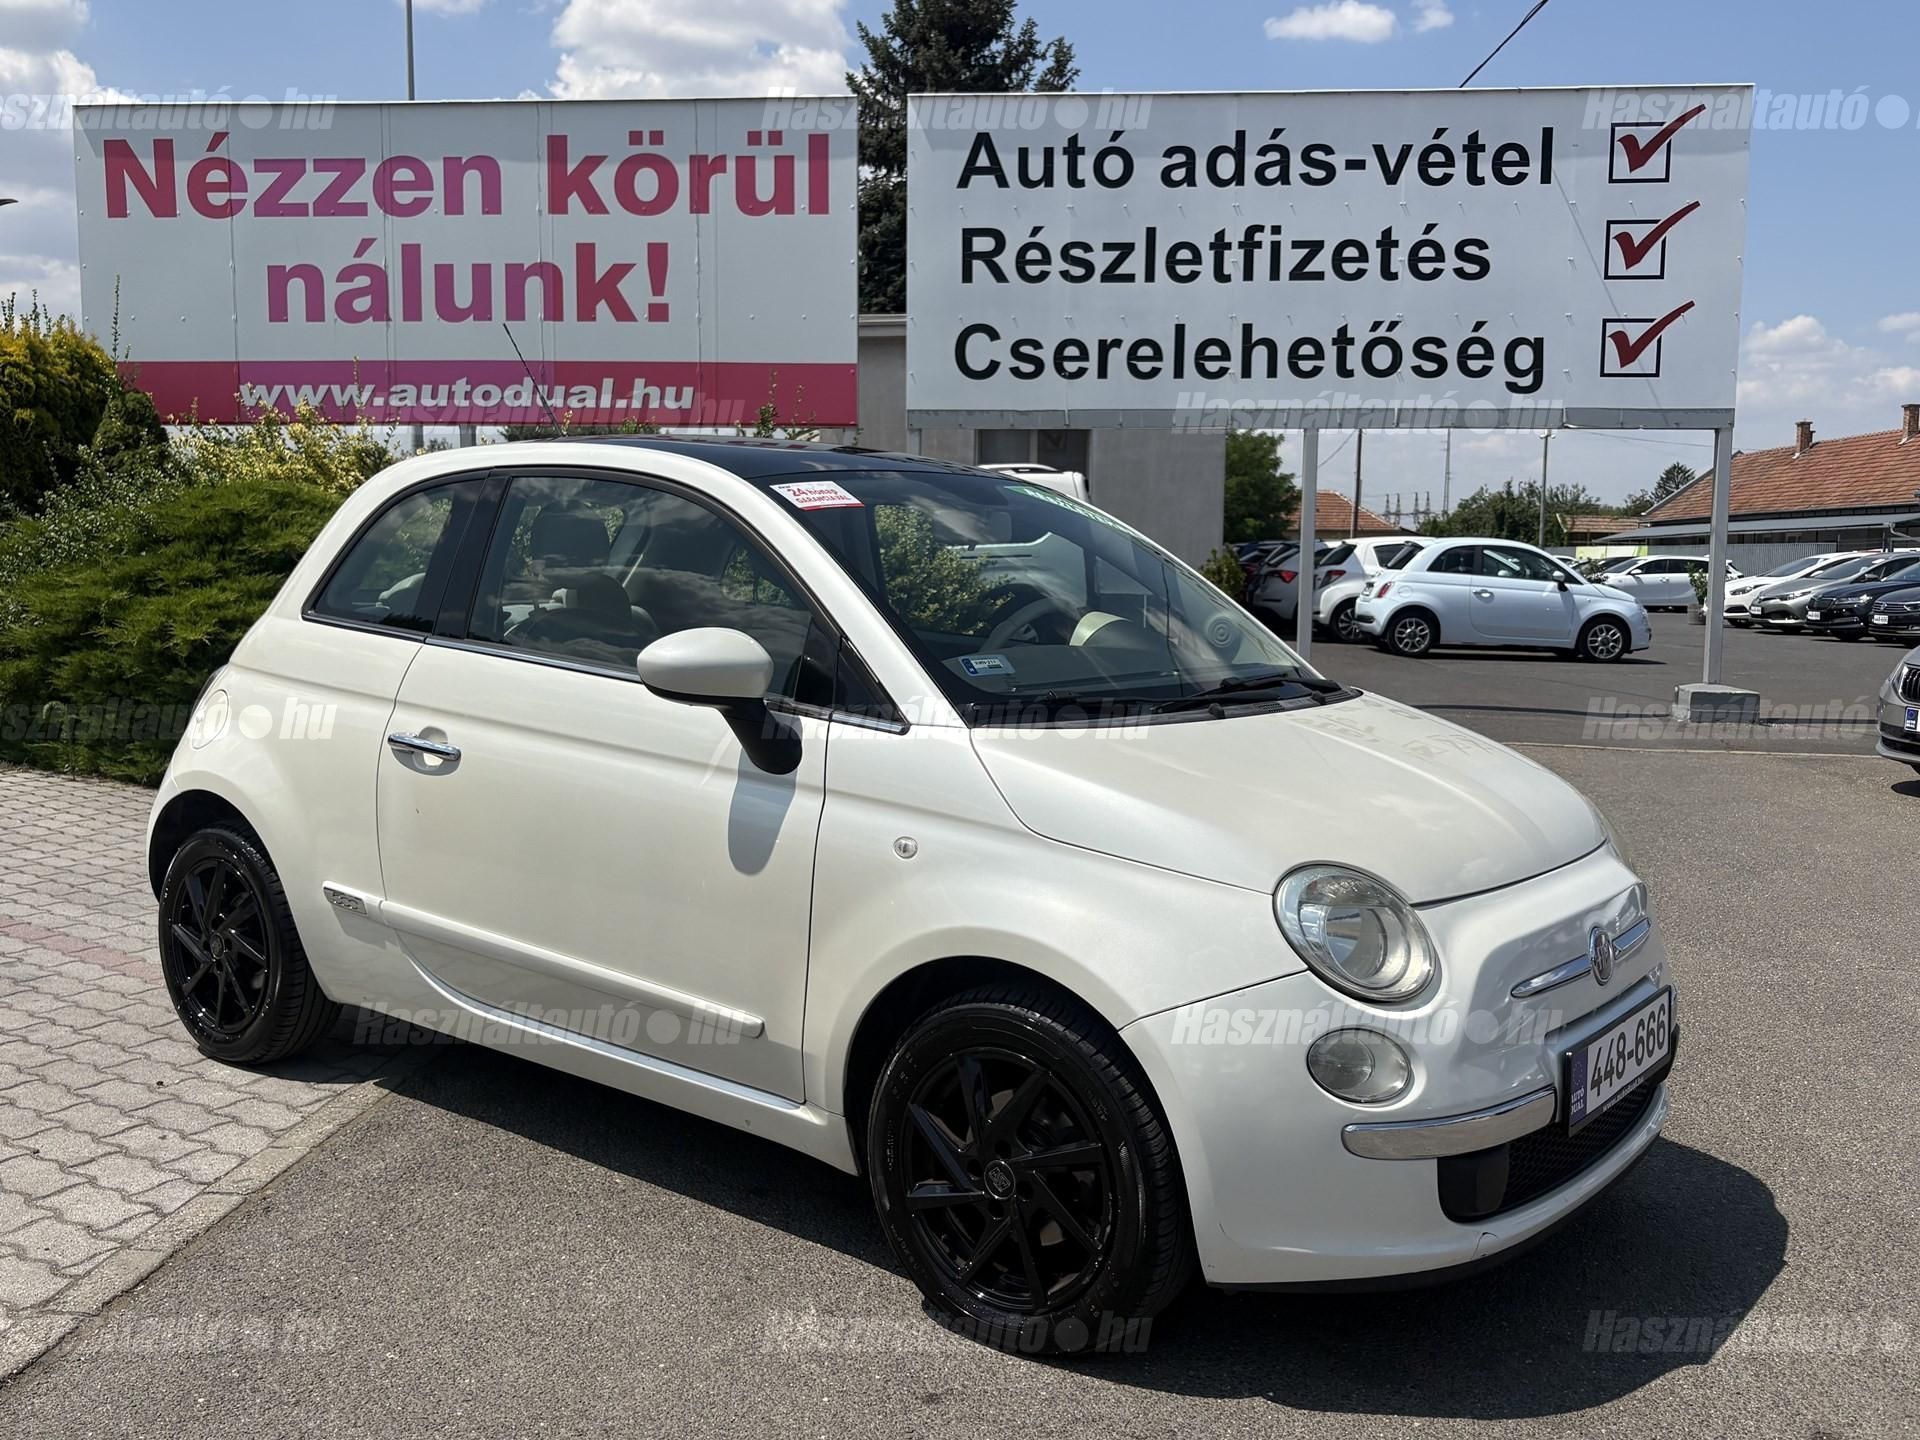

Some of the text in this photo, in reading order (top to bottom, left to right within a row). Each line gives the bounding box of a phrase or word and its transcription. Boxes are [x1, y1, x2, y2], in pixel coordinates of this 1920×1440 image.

[104, 131, 830, 219] Nézzen körül
[956, 126, 1555, 189] Autó adás-vétel
[267, 238, 670, 323] nálunk!
[960, 223, 1491, 284] Részletfizetés
[240, 377, 694, 411] www.autodual.hu
[954, 320, 1545, 394] Cserelehetőség
[1590, 1003, 1666, 1097] 448-666
